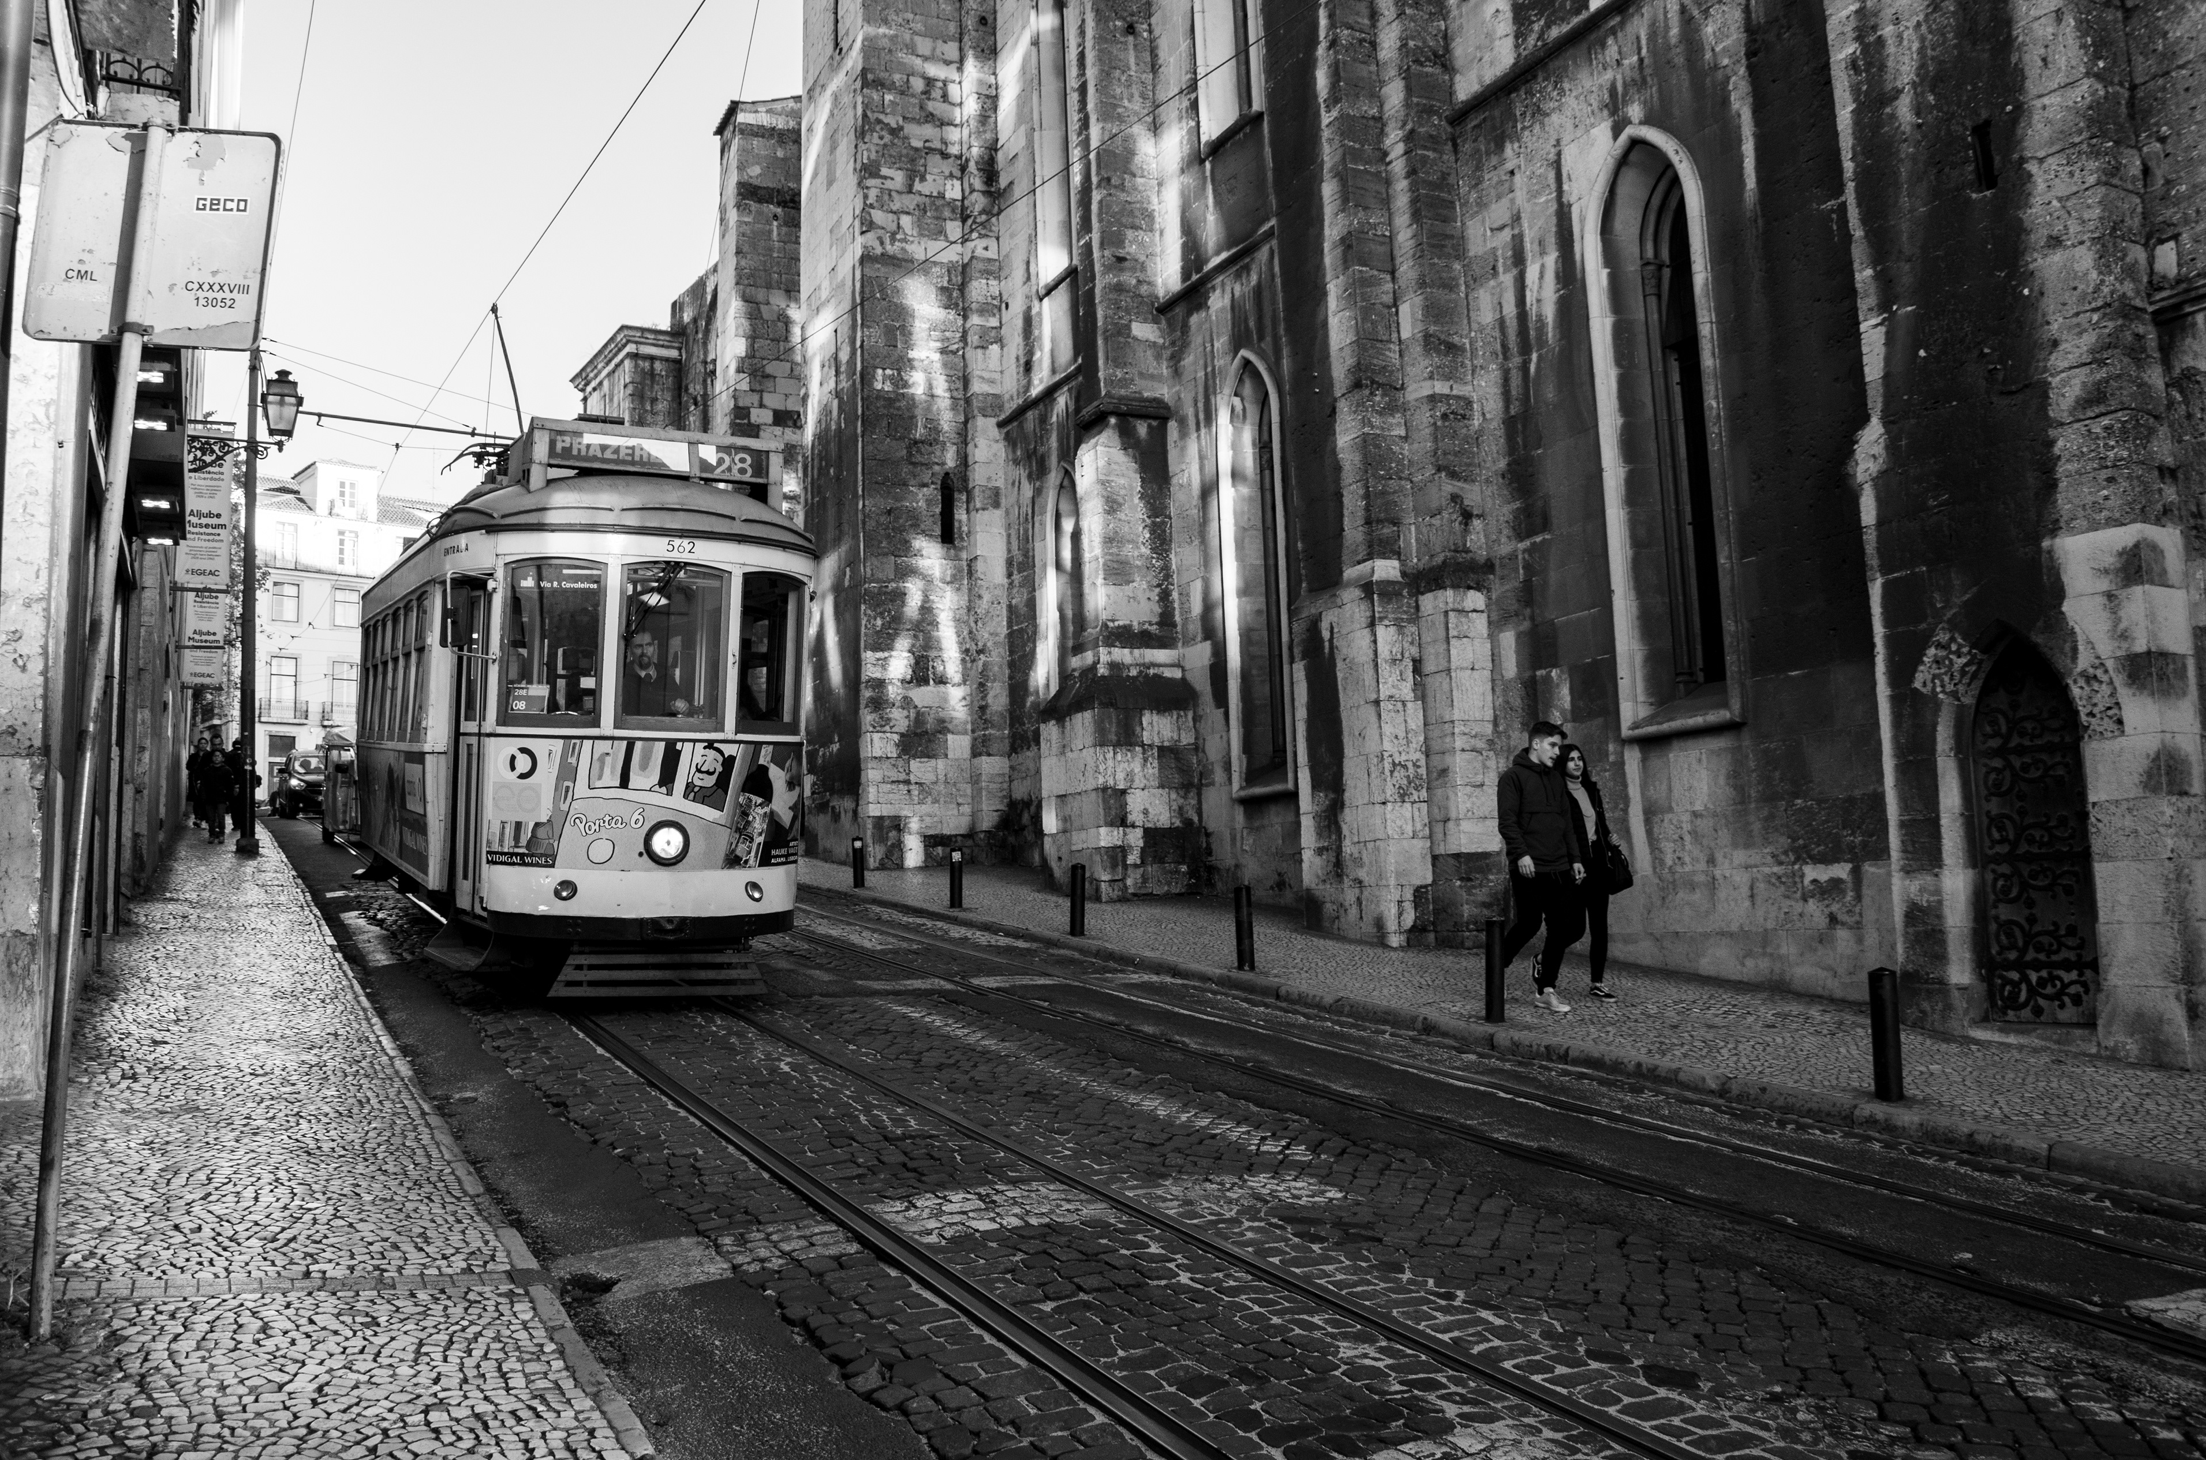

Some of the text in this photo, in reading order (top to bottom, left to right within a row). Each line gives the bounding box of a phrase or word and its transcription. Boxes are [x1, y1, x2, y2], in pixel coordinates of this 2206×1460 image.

[65, 268, 98, 282] CML
[184, 280, 250, 295] CXXXVIII
[194, 296, 236, 309] 13052
[555, 435, 663, 463] PRAZER
[714, 451, 752, 477] 28
[188, 509, 222, 520] Aljube
[187, 529, 221, 537] Resistance
[443, 542, 469, 557] ENTRAA
[666, 540, 696, 554] 562
[190, 568, 221, 577] EGEAC
[539, 580, 598, 589] Via R. Cavaleiros
[194, 591, 220, 601] Aljube
[192, 629, 218, 638] Aljube
[187, 636, 221, 645] Museum
[512, 700, 527, 710] 08
[570, 806, 646, 837] Porta 6
[487, 854, 553, 865] VIDIGAL WINES
